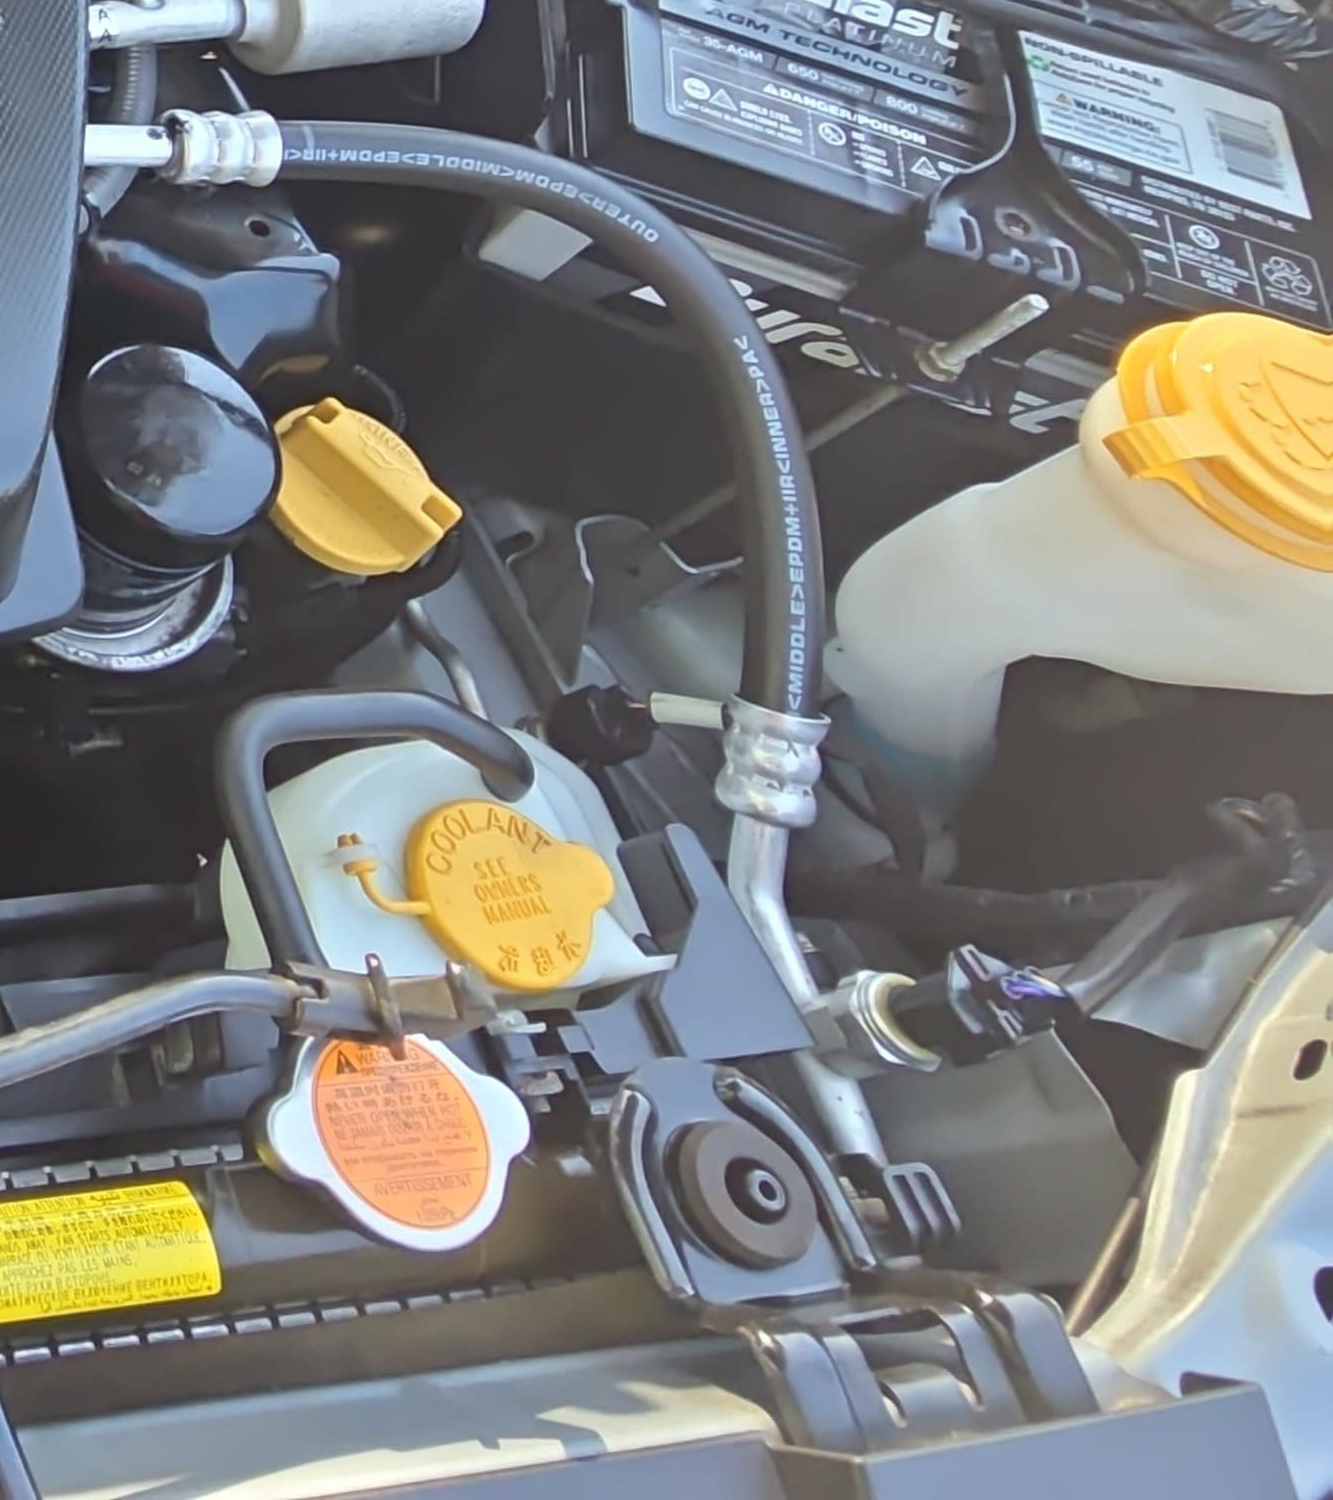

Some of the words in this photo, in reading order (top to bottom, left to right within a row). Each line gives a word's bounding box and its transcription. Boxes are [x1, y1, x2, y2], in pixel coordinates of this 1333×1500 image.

[705, 8, 769, 34] AGM
[779, 28, 969, 98] TECHNOLOGY
[784, 2, 956, 69] PLATINUM
[426, 808, 552, 875] COOLANT
[474, 856, 509, 879] SEE
[474, 873, 542, 901] OWNERS
[483, 896, 552, 924] MANUAL
